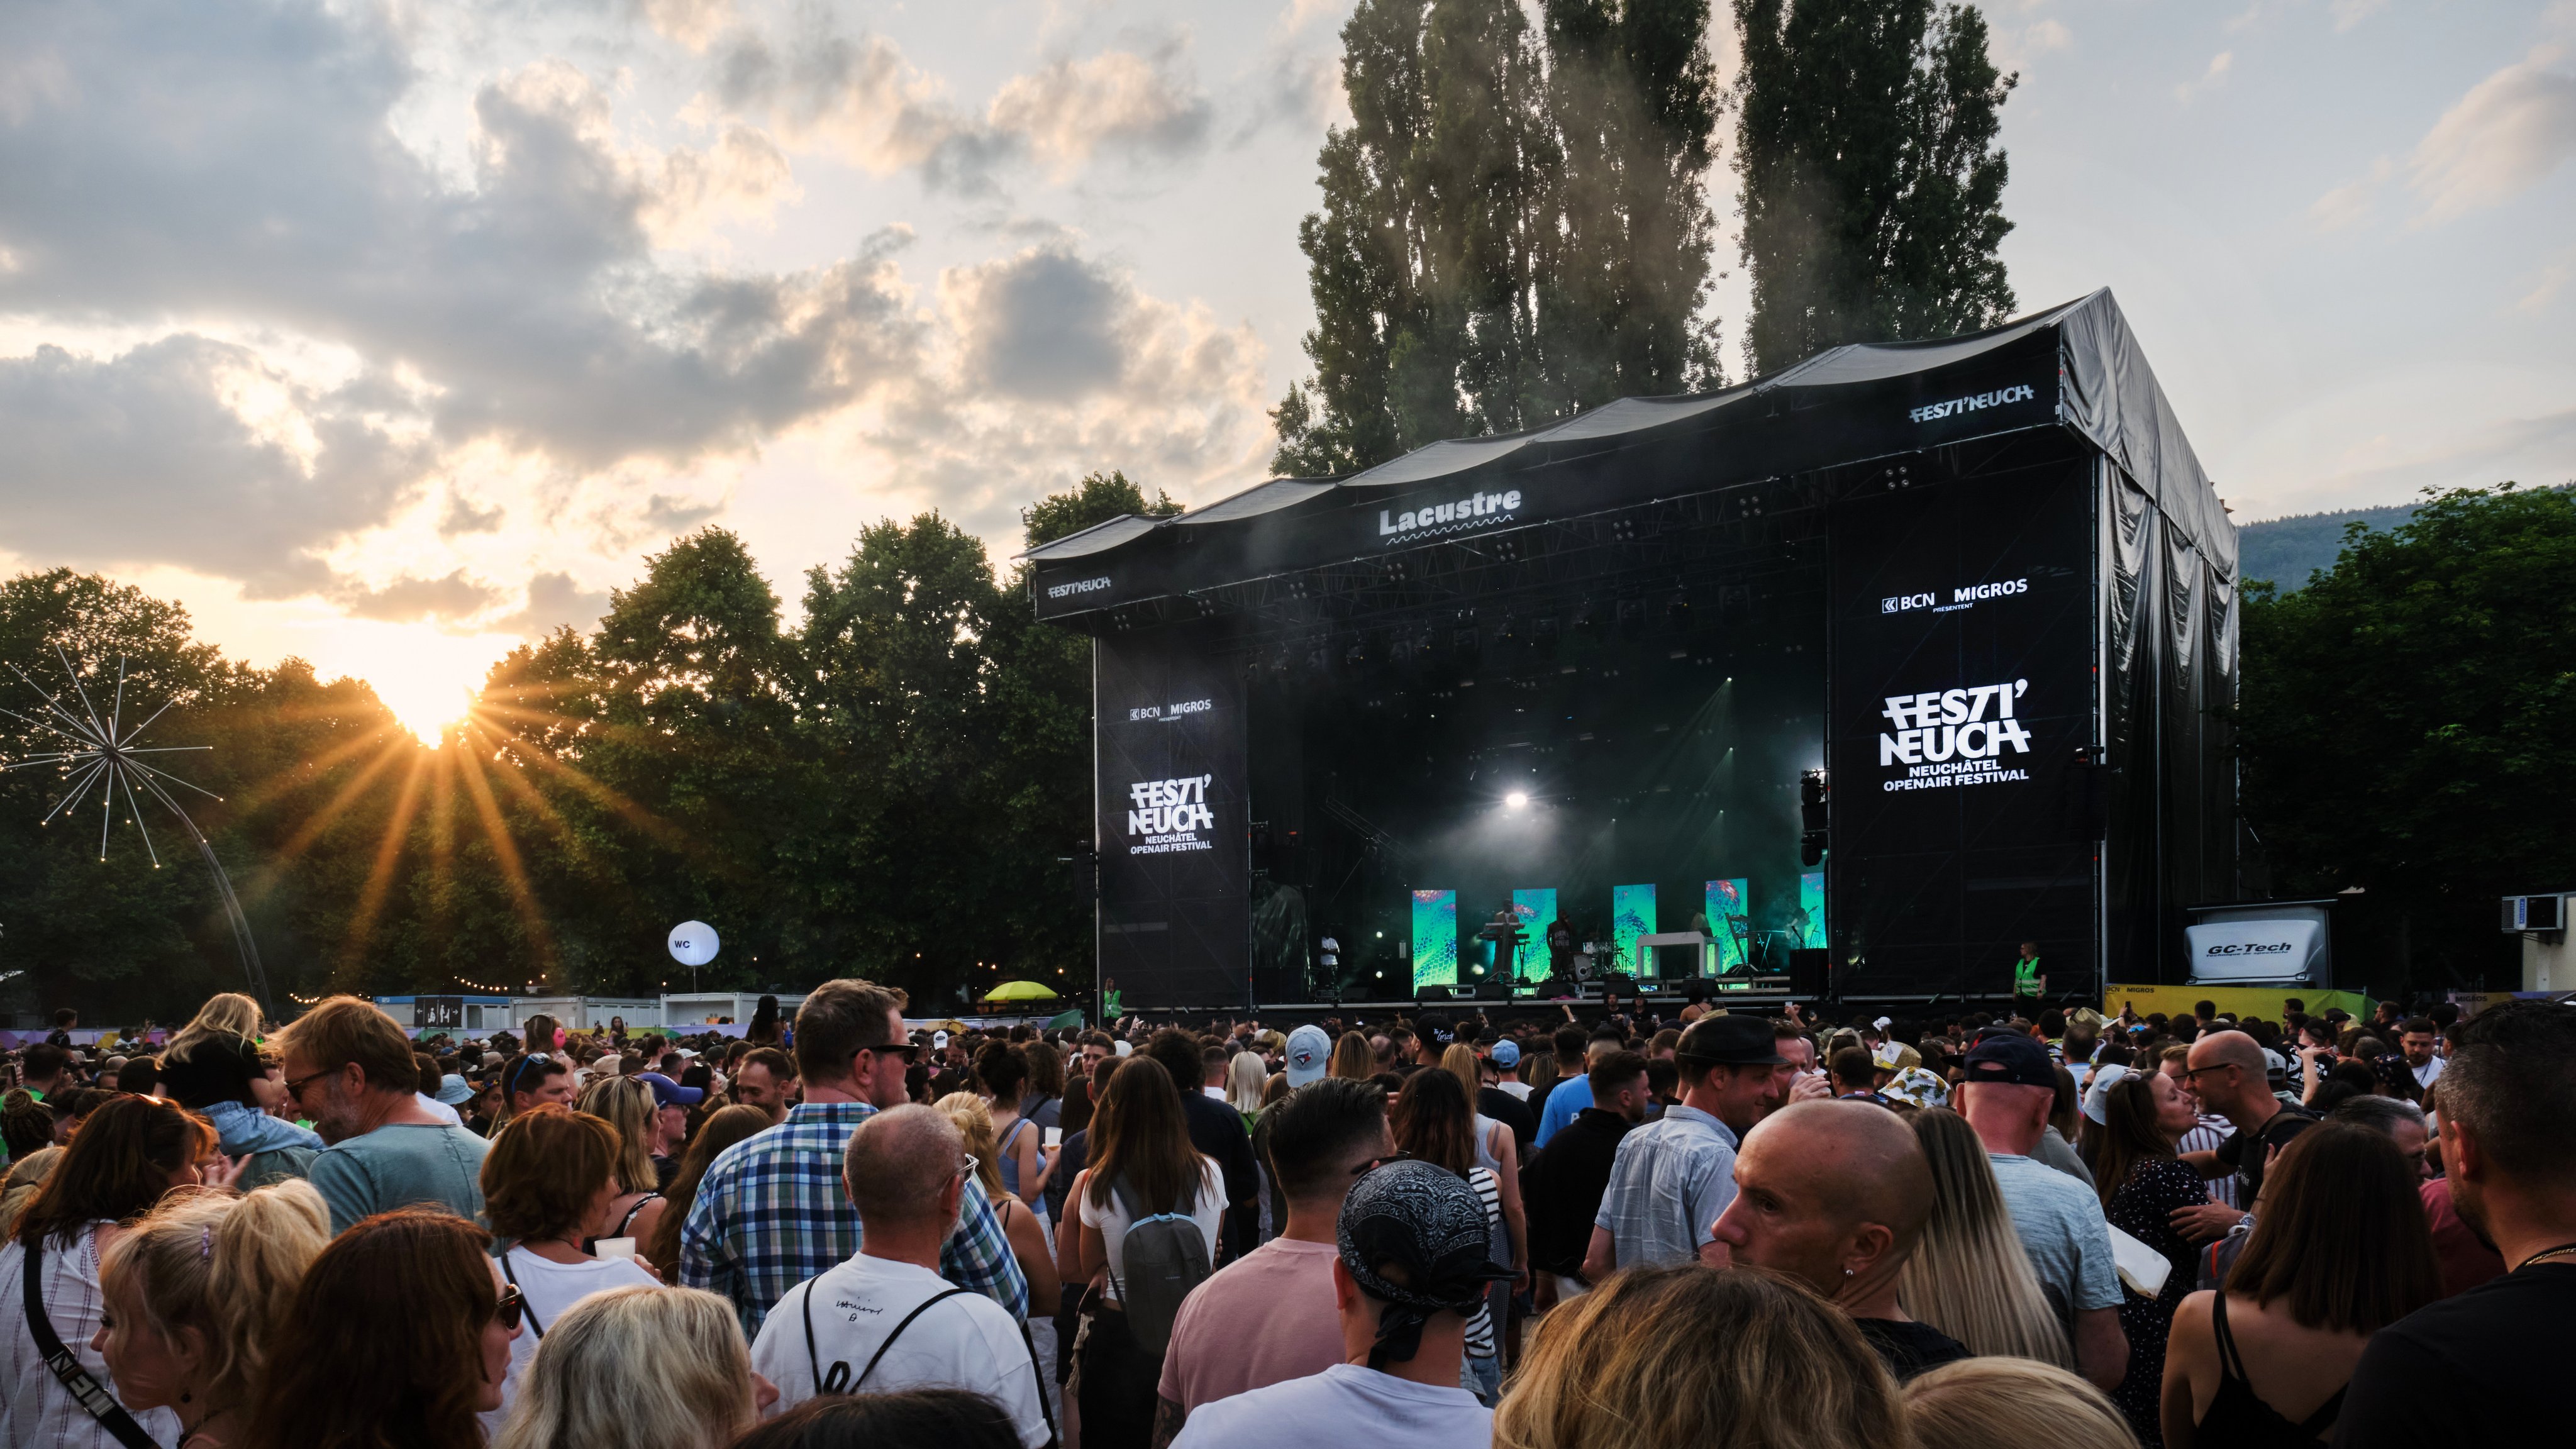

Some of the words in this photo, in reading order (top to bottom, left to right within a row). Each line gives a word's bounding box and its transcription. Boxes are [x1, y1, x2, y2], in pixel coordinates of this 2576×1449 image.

[1380, 490, 1521, 535] Lacustre
[1901, 593, 1935, 609] BCN
[1955, 579, 2028, 602] MIGROS
[1141, 707, 1160, 718] BCN
[1170, 699, 1211, 715] MIGROS
[1882, 679, 2029, 730] FESTI'
[1880, 719, 2032, 766] NEUCH
[1909, 759, 2001, 777] NEUCHÂTEL
[1130, 774, 1212, 808] FESTI'
[1884, 776, 1951, 792] OPENAIR
[1955, 769, 2029, 786] FESTIVAL
[1129, 803, 1214, 835] NEUCH
[1131, 843, 1170, 855] OPENAIR
[1171, 841, 1213, 852] FESTIVAL
[1145, 832, 1197, 844] NEUCHÂTEL
[674, 940, 691, 948] WC
[2208, 943, 2292, 954] GC-Tech
